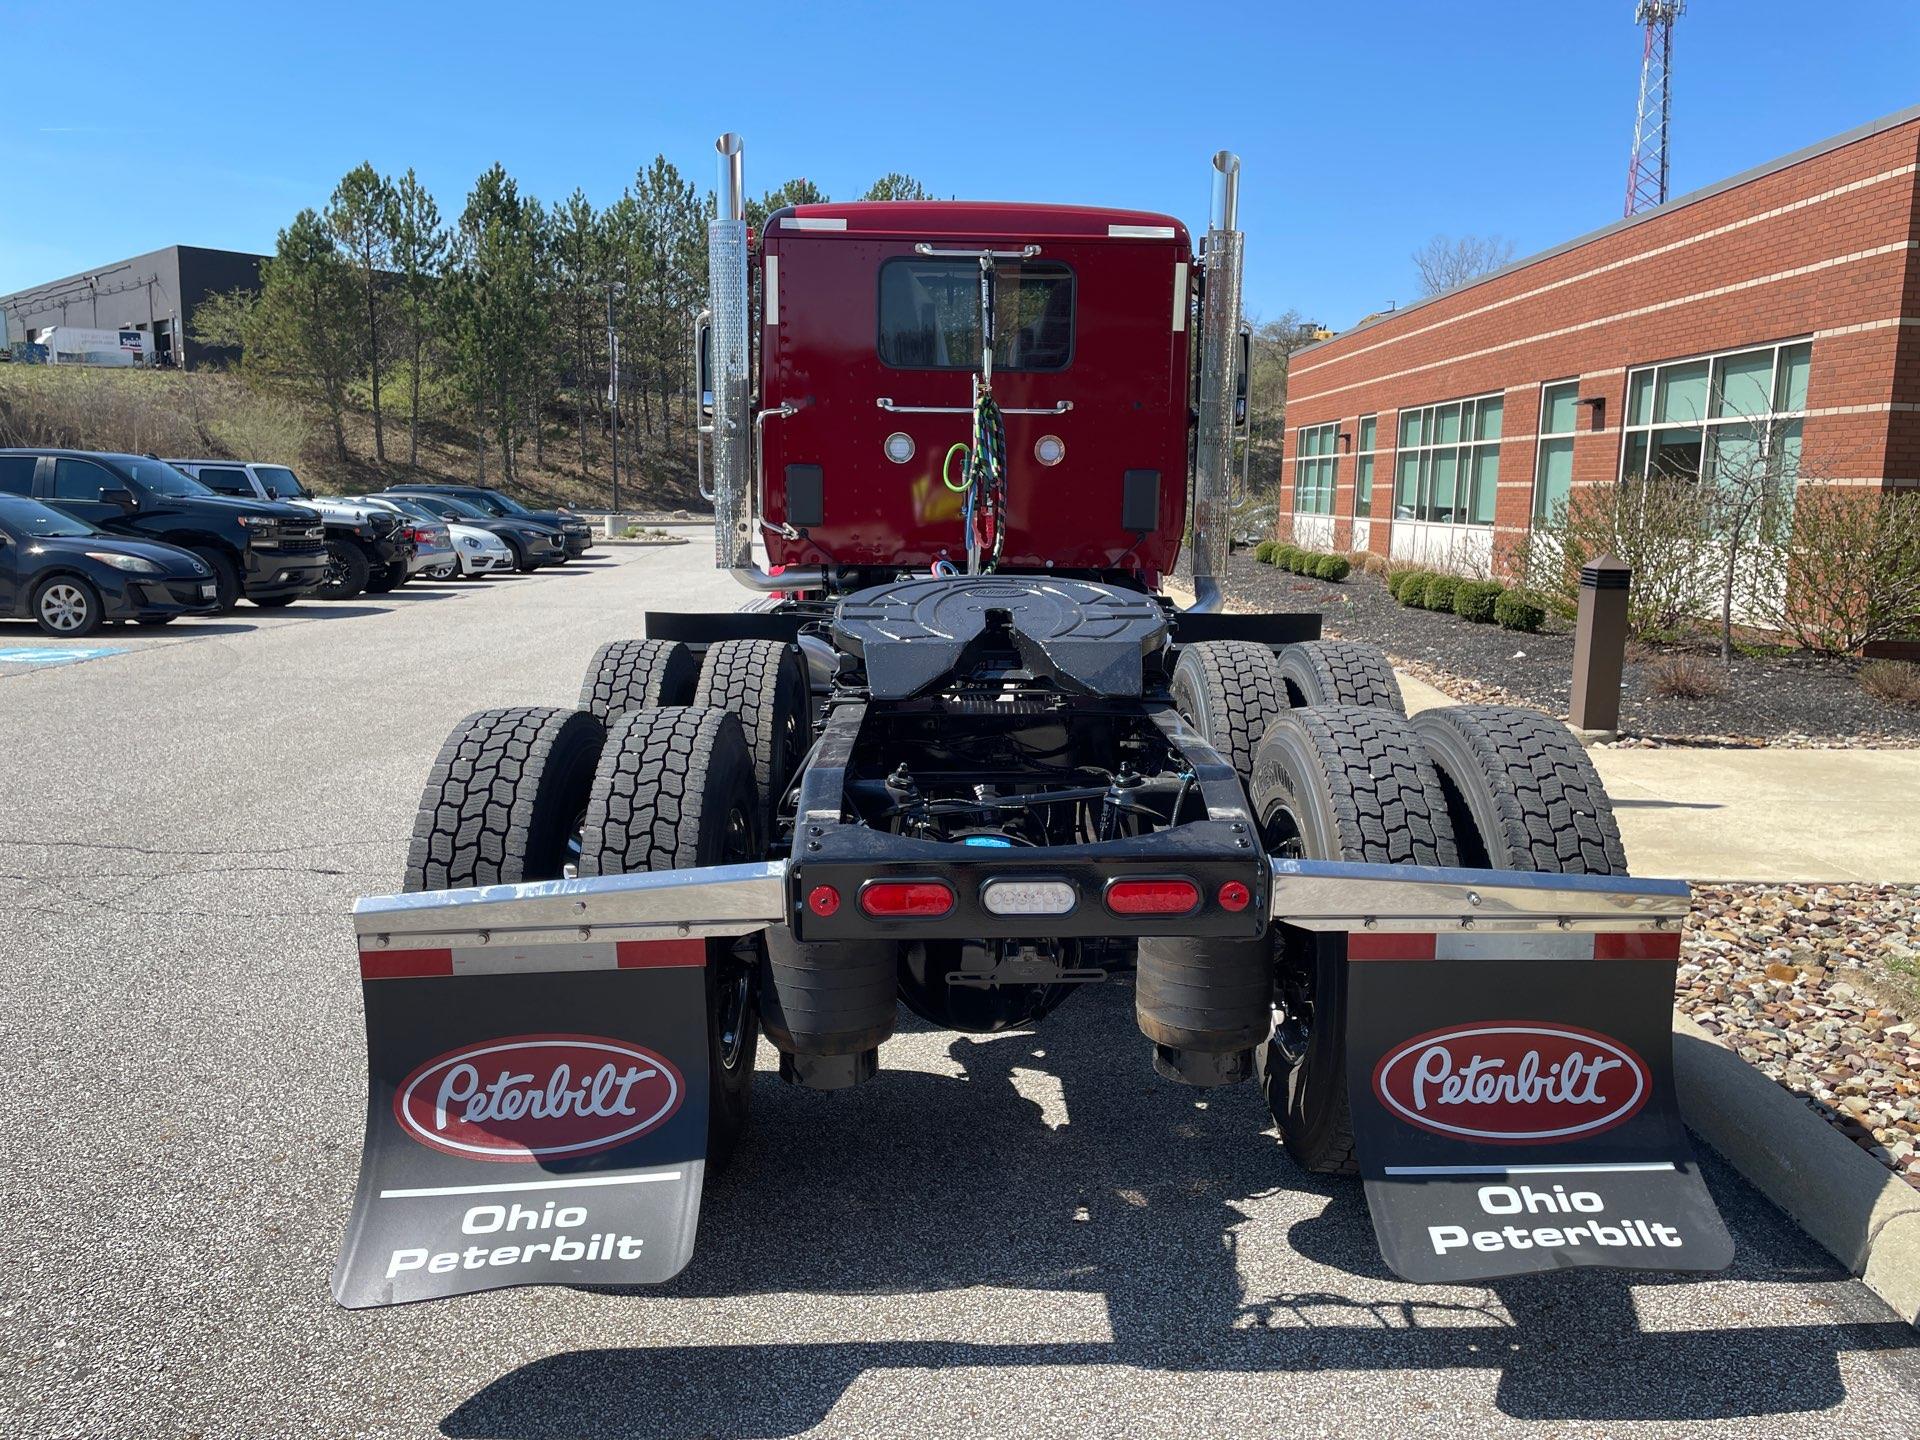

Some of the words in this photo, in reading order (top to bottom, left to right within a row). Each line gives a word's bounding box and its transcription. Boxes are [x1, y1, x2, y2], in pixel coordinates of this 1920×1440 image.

[436, 1063, 656, 1130] Peterbilt
[1412, 1046, 1621, 1110] Peterbilt
[461, 1201, 588, 1235] Ohio
[1477, 1184, 1604, 1214] Ohio
[385, 1233, 643, 1279] Peterbilt
[1428, 1219, 1682, 1255] Peterbilt
